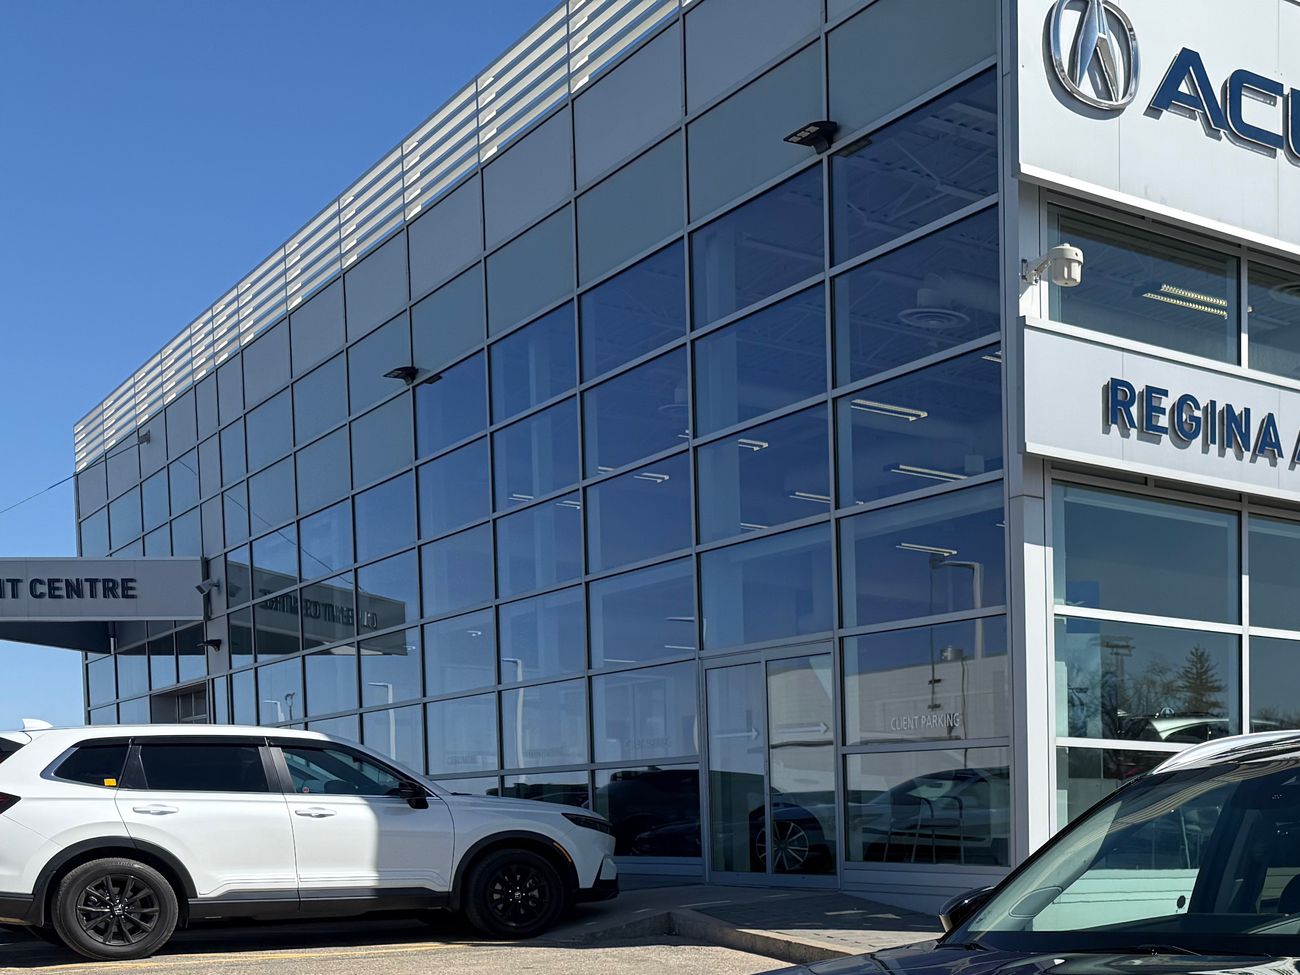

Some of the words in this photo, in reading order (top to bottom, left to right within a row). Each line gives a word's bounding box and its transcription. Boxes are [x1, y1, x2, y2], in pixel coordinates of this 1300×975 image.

[1107, 377, 1284, 459] REGINA
[29, 578, 138, 600] CENTRE
[890, 715, 919, 731] CLIENT
[920, 712, 960, 729] PARKING
